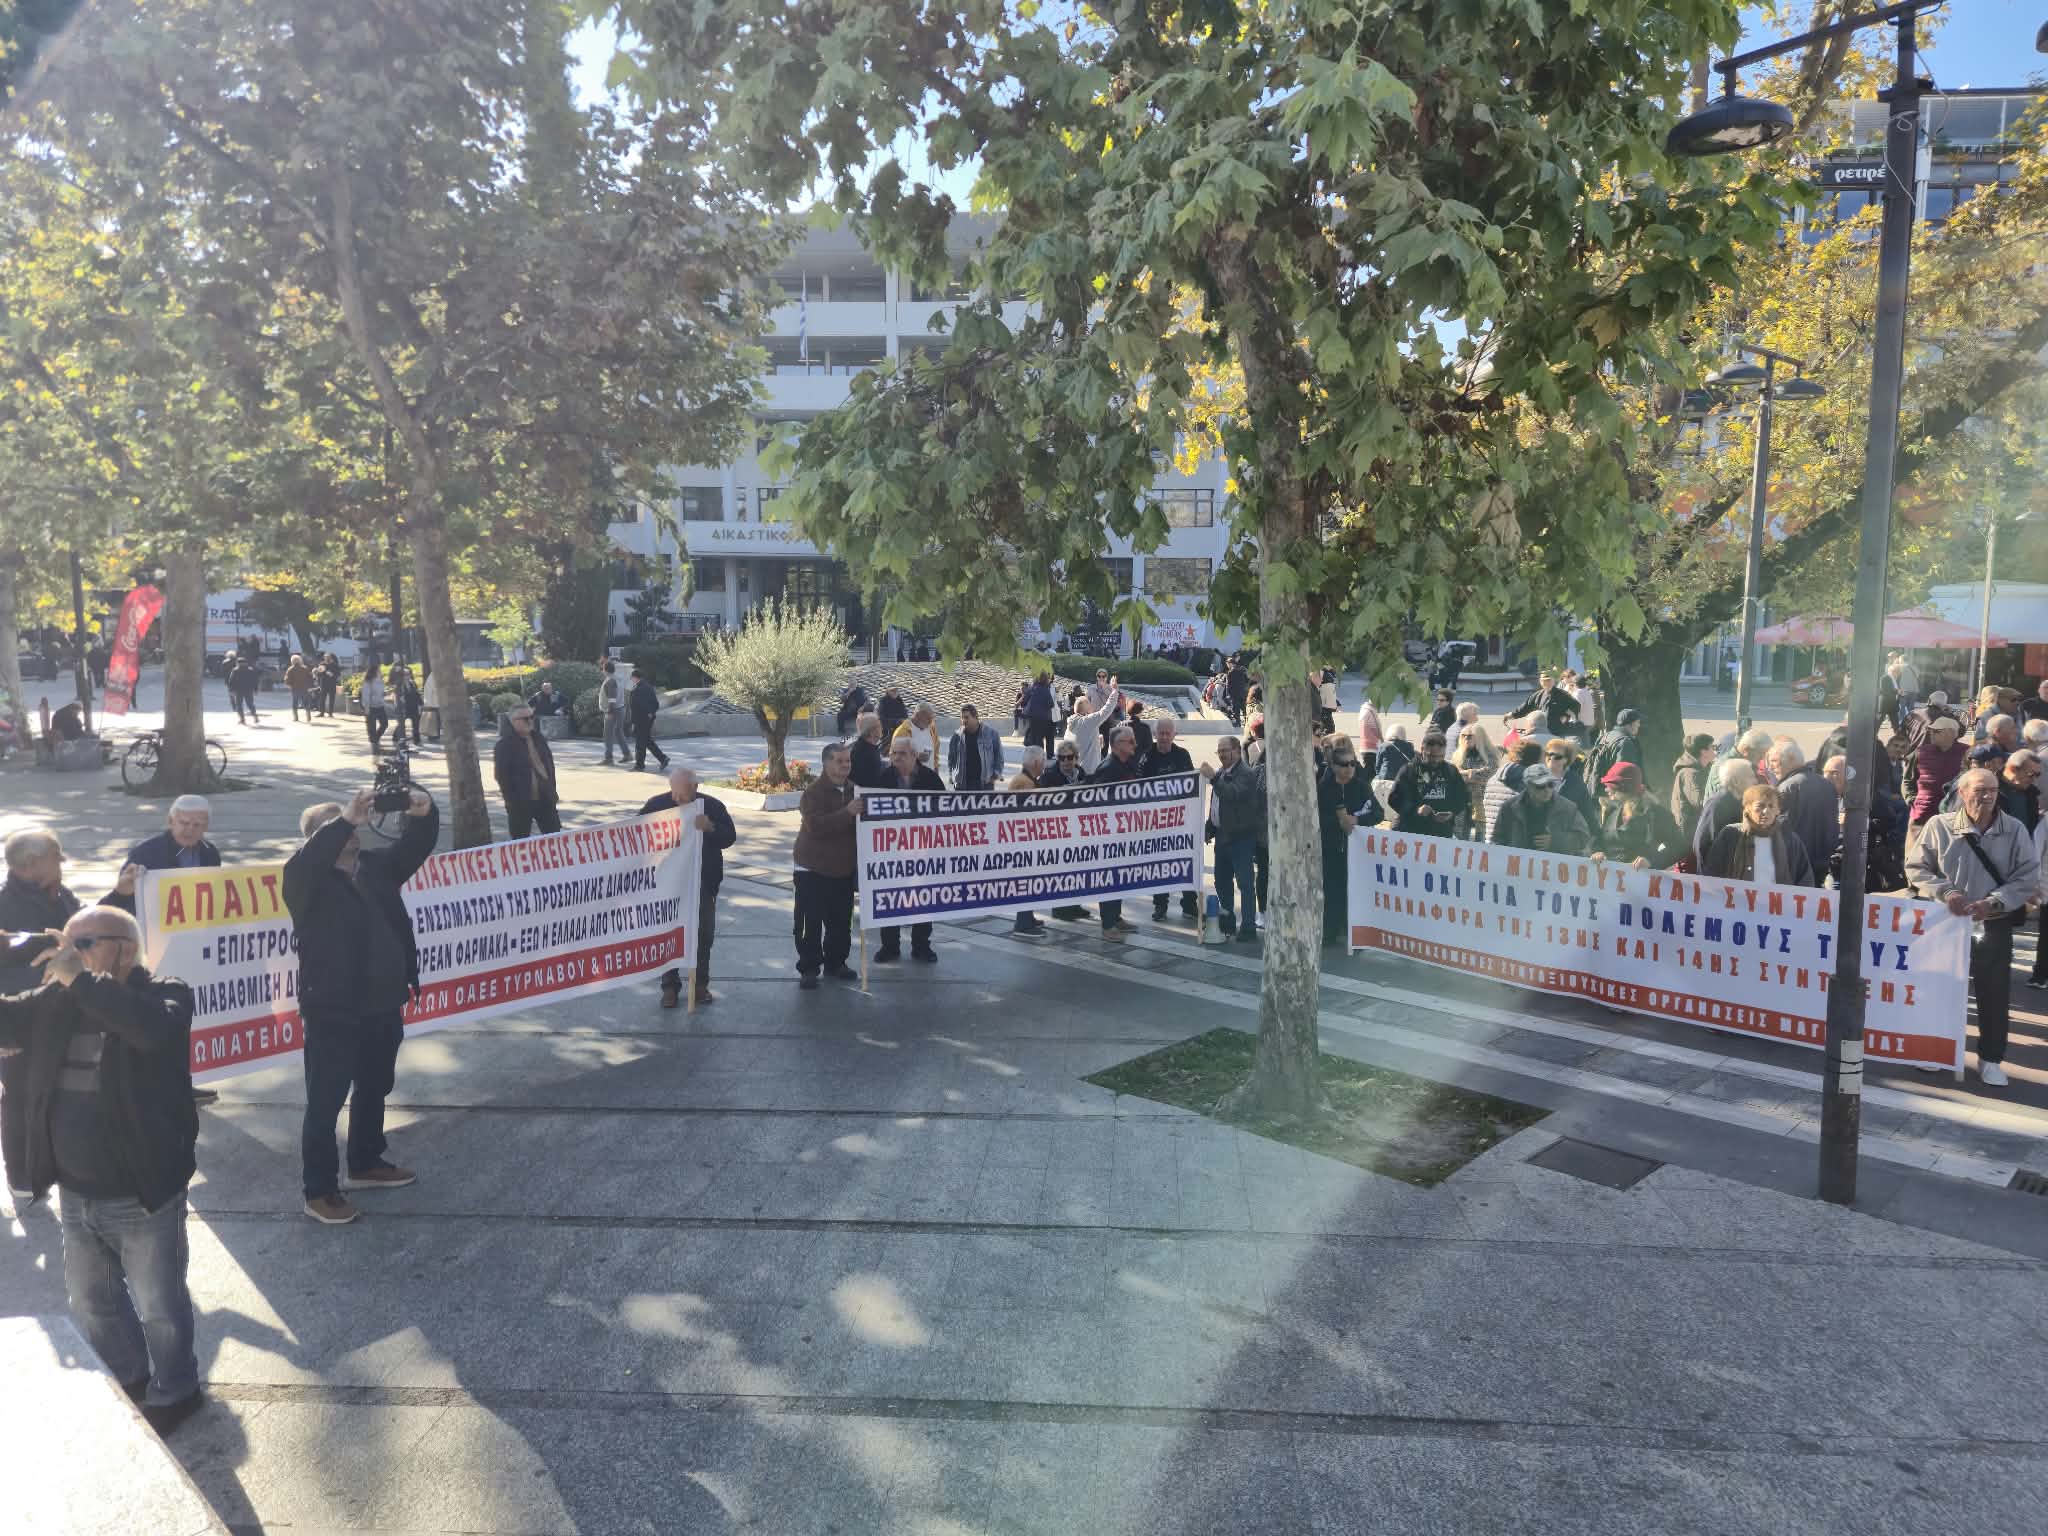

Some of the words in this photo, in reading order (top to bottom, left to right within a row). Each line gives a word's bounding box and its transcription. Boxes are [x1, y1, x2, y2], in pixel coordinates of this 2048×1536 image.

[1834, 165, 1886, 182] ρετιρέ
[867, 797, 910, 816] ΕΞΩ
[917, 796, 931, 813] Η
[938, 792, 1018, 811] ΕΛΛΑΔΑ
[1023, 790, 1066, 808] ΑΠΟ
[1072, 783, 1109, 803] ΤΟΝ
[1114, 777, 1195, 800] ΠΟΛΕΜΟ
[500, 837, 574, 876] ΑΥΞΗΣΕΙΣ
[576, 830, 609, 865] ΣΤΙΣ
[609, 818, 681, 858] ΣΥΝΤΑΞΕΙΣ
[872, 821, 989, 853] ΠΡΑΓΜΑΤΙΚΕΣ
[998, 816, 1072, 845] ΑΥΞΗΣΕΙΣ
[1079, 813, 1111, 837] ΣΤΙΣ
[1116, 804, 1186, 834] ΣΥΝΤΑΞΕΙΣ
[866, 857, 946, 881] ΚΑΤΑΒΟΛΗ
[950, 854, 979, 874] ΤΩΝ
[983, 850, 1033, 871] ΔΩΡΩΝ
[1036, 847, 1060, 866] ΚΑΙ
[1062, 843, 1099, 863] ΟΛΩΝ
[1102, 840, 1126, 859] ΤΩΝ
[1128, 833, 1195, 857] ΚΛΕΜΕΝΩΝ
[165, 874, 279, 926] ΑΠΑΙΤ
[416, 897, 504, 934] ΕΝΣΩΜΑΤΩΣΗ
[507, 890, 531, 916] ΤΗΣ
[533, 876, 604, 913] ΠΡΟΣΩΠΙΚΗΣ
[606, 866, 656, 898] ΔΙΑΦΟΡΑΣ
[875, 887, 963, 911] ΣΥΛΛΟΓΟΣ
[967, 875, 1086, 902] ΣΥΝΤΑΞΙΟΥΧΩΝ
[1090, 871, 1114, 887] ΙΚΑ
[1118, 859, 1193, 885] ΤΥΡΝΑΒΟΥ
[1454, 847, 1489, 872] ΓΙΑ
[1506, 855, 1626, 892] ΜΙΣΘΟΥΣ
[1648, 874, 1700, 904] ΚΑΙ
[1724, 886, 1926, 935] ΣΥΝΤΑΕΙΣ
[416, 944, 452, 974] ΩΡΕΑΝ
[456, 931, 509, 967] ΦΑΡΜΑΚΑ
[520, 930, 540, 954] ΕΞΩ
[542, 927, 549, 949] Η
[552, 915, 587, 946] ΕΛΛΑΔΑ
[589, 911, 608, 939] ΑΠΟ
[611, 906, 634, 933] ΤΟΥΣ
[1375, 892, 1483, 928] ΕΠΑΝΑΦΟΡΑ
[1498, 915, 1532, 939] ΤΗΣ
[1616, 937, 1659, 961] ΚΑΙ
[1677, 948, 1739, 977] 14ΗΣ
[1376, 864, 1408, 888] ΚΑΙ
[1425, 872, 1461, 897] ΟΧΙ
[1479, 880, 1516, 906] ΓΙΑ
[1535, 889, 1597, 920] ΤΟΥΣ
[1619, 903, 1791, 953] ΠΟΛΕΜΟΥΣ
[1818, 934, 1909, 971] ΤΥΣ
[217, 928, 300, 965] ΕΠΙΣΤΡΟΦ
[503, 959, 585, 994] ΤΥΡΝΑΒΟΥ
[591, 956, 599, 974] &
[194, 1022, 293, 1063] ΩΜΑΤΕΙΟ
[1649, 992, 1767, 1028] ΟΡΓΑΝΩΣΕΙΣ
[1780, 1017, 1905, 1053] ΜΑΓΙΑΣ
